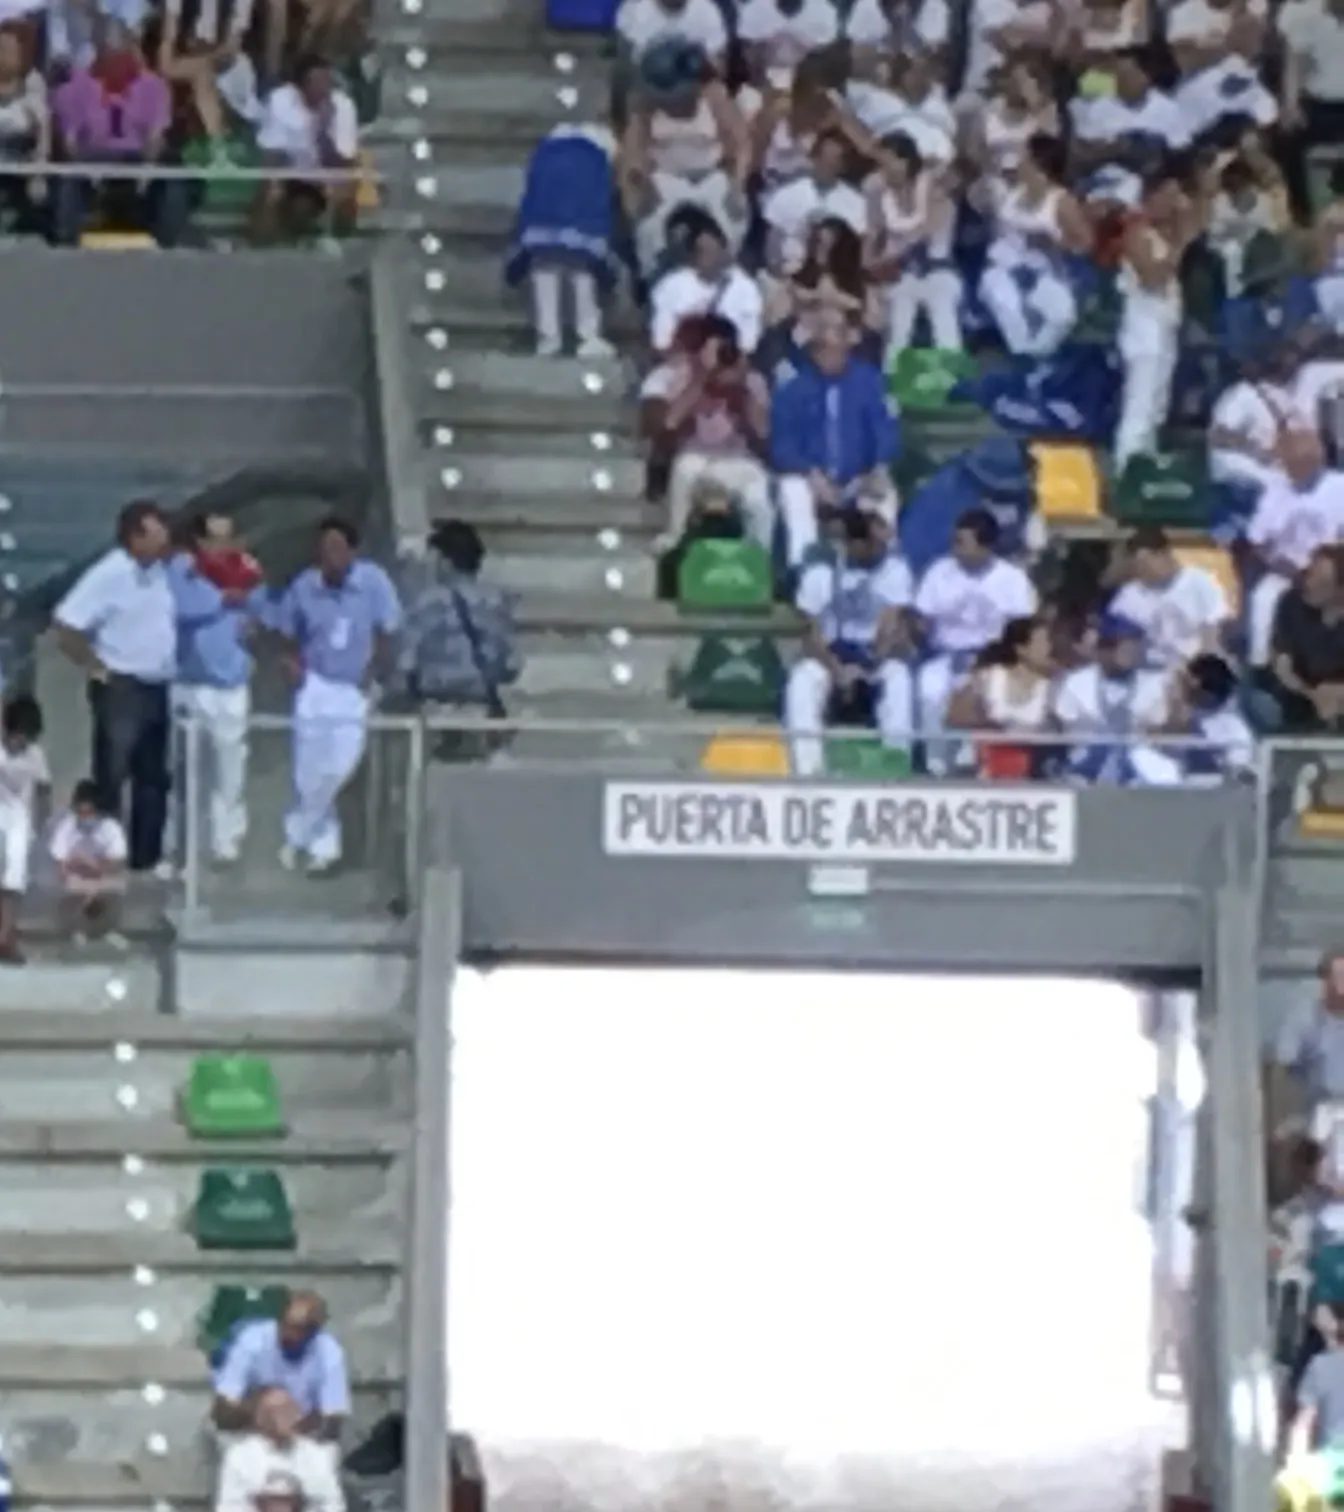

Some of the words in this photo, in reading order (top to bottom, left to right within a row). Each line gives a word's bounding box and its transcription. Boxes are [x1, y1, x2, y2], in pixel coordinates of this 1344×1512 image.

[619, 792, 769, 846] PUERTA
[782, 797, 834, 849] DE
[846, 797, 1058, 853] ARRASTRE
